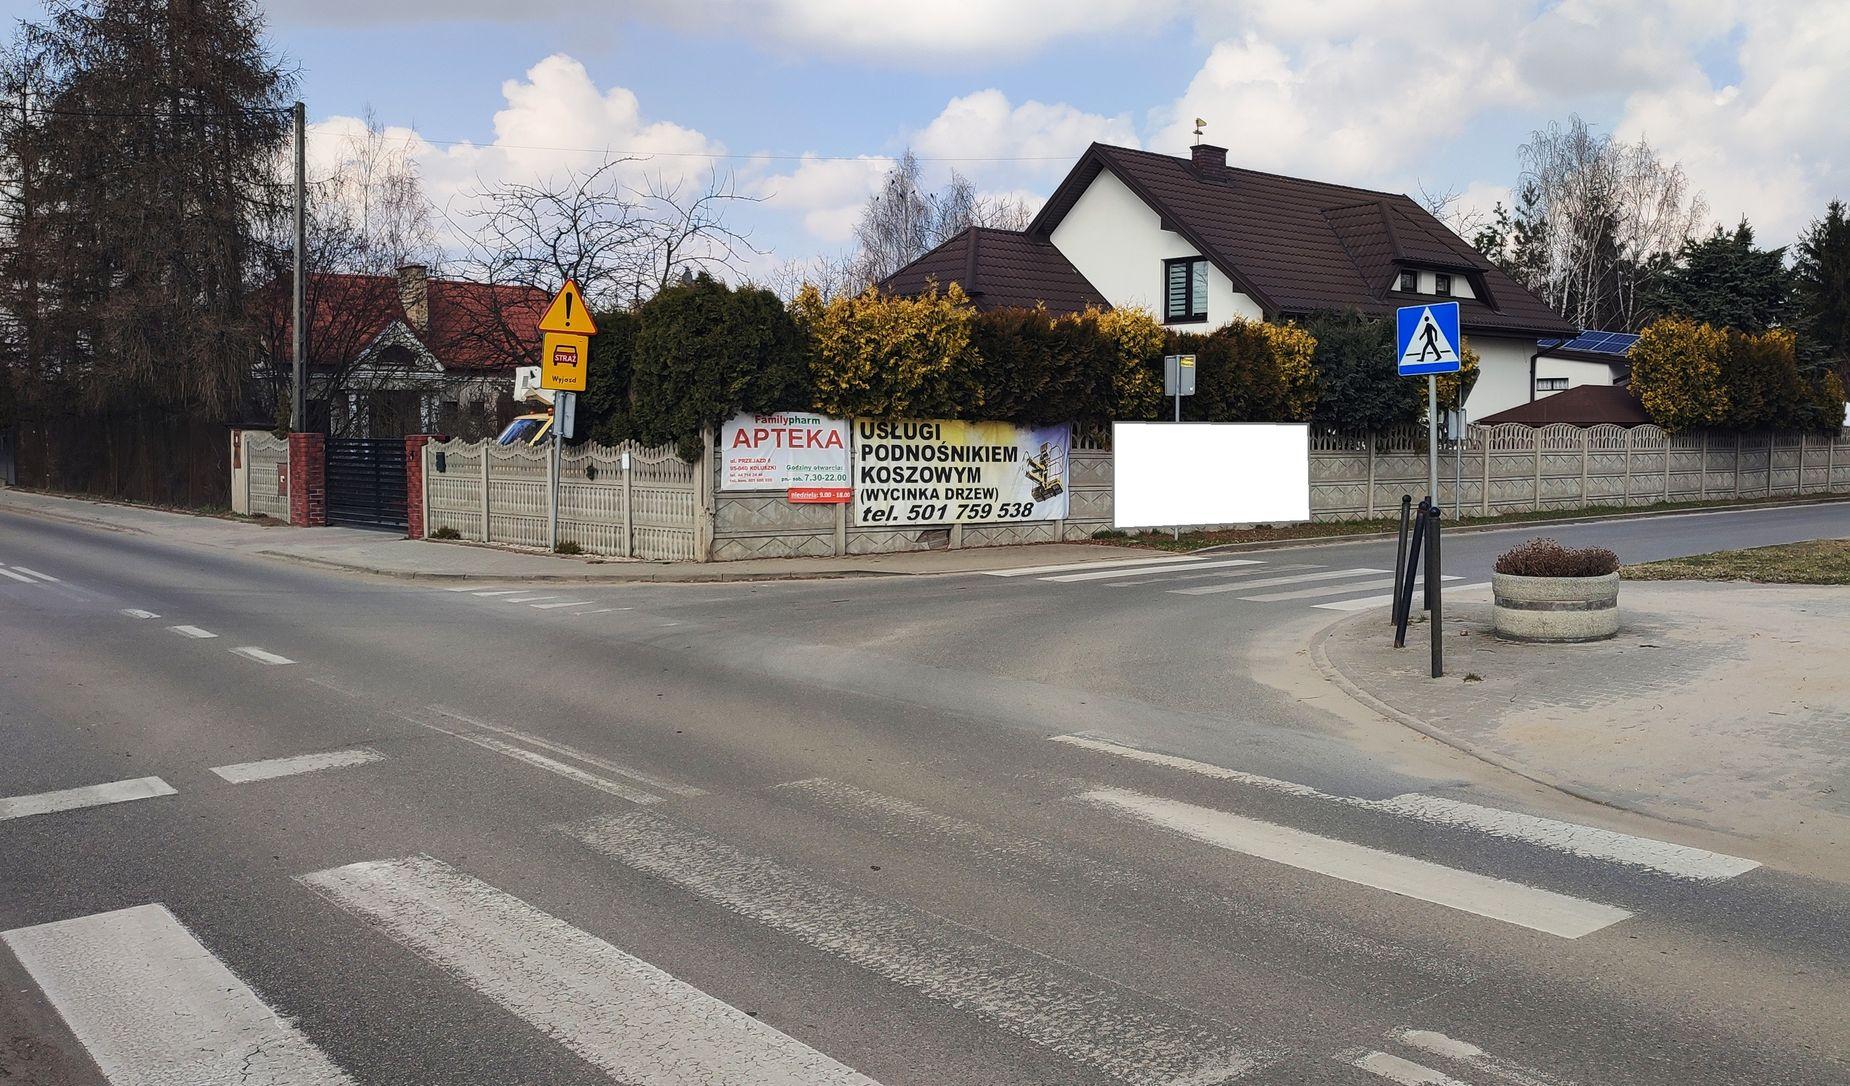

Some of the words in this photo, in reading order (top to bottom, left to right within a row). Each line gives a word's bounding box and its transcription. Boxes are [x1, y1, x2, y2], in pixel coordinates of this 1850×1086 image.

[554, 354, 577, 363] STRAŻ
[755, 415, 820, 426] Familypharm
[732, 428, 844, 449] APTEKA
[860, 422, 941, 440] USŁUGI
[861, 441, 1018, 462] PODNOŚNIKIEM
[861, 466, 981, 484] KOSZOWYM
[860, 488, 940, 504] (WYCINKA
[944, 487, 999, 502] DRZEW)
[862, 505, 898, 522] tel.
[906, 504, 948, 520] 501
[956, 504, 992, 520] 759
[997, 502, 1034, 518] 538
